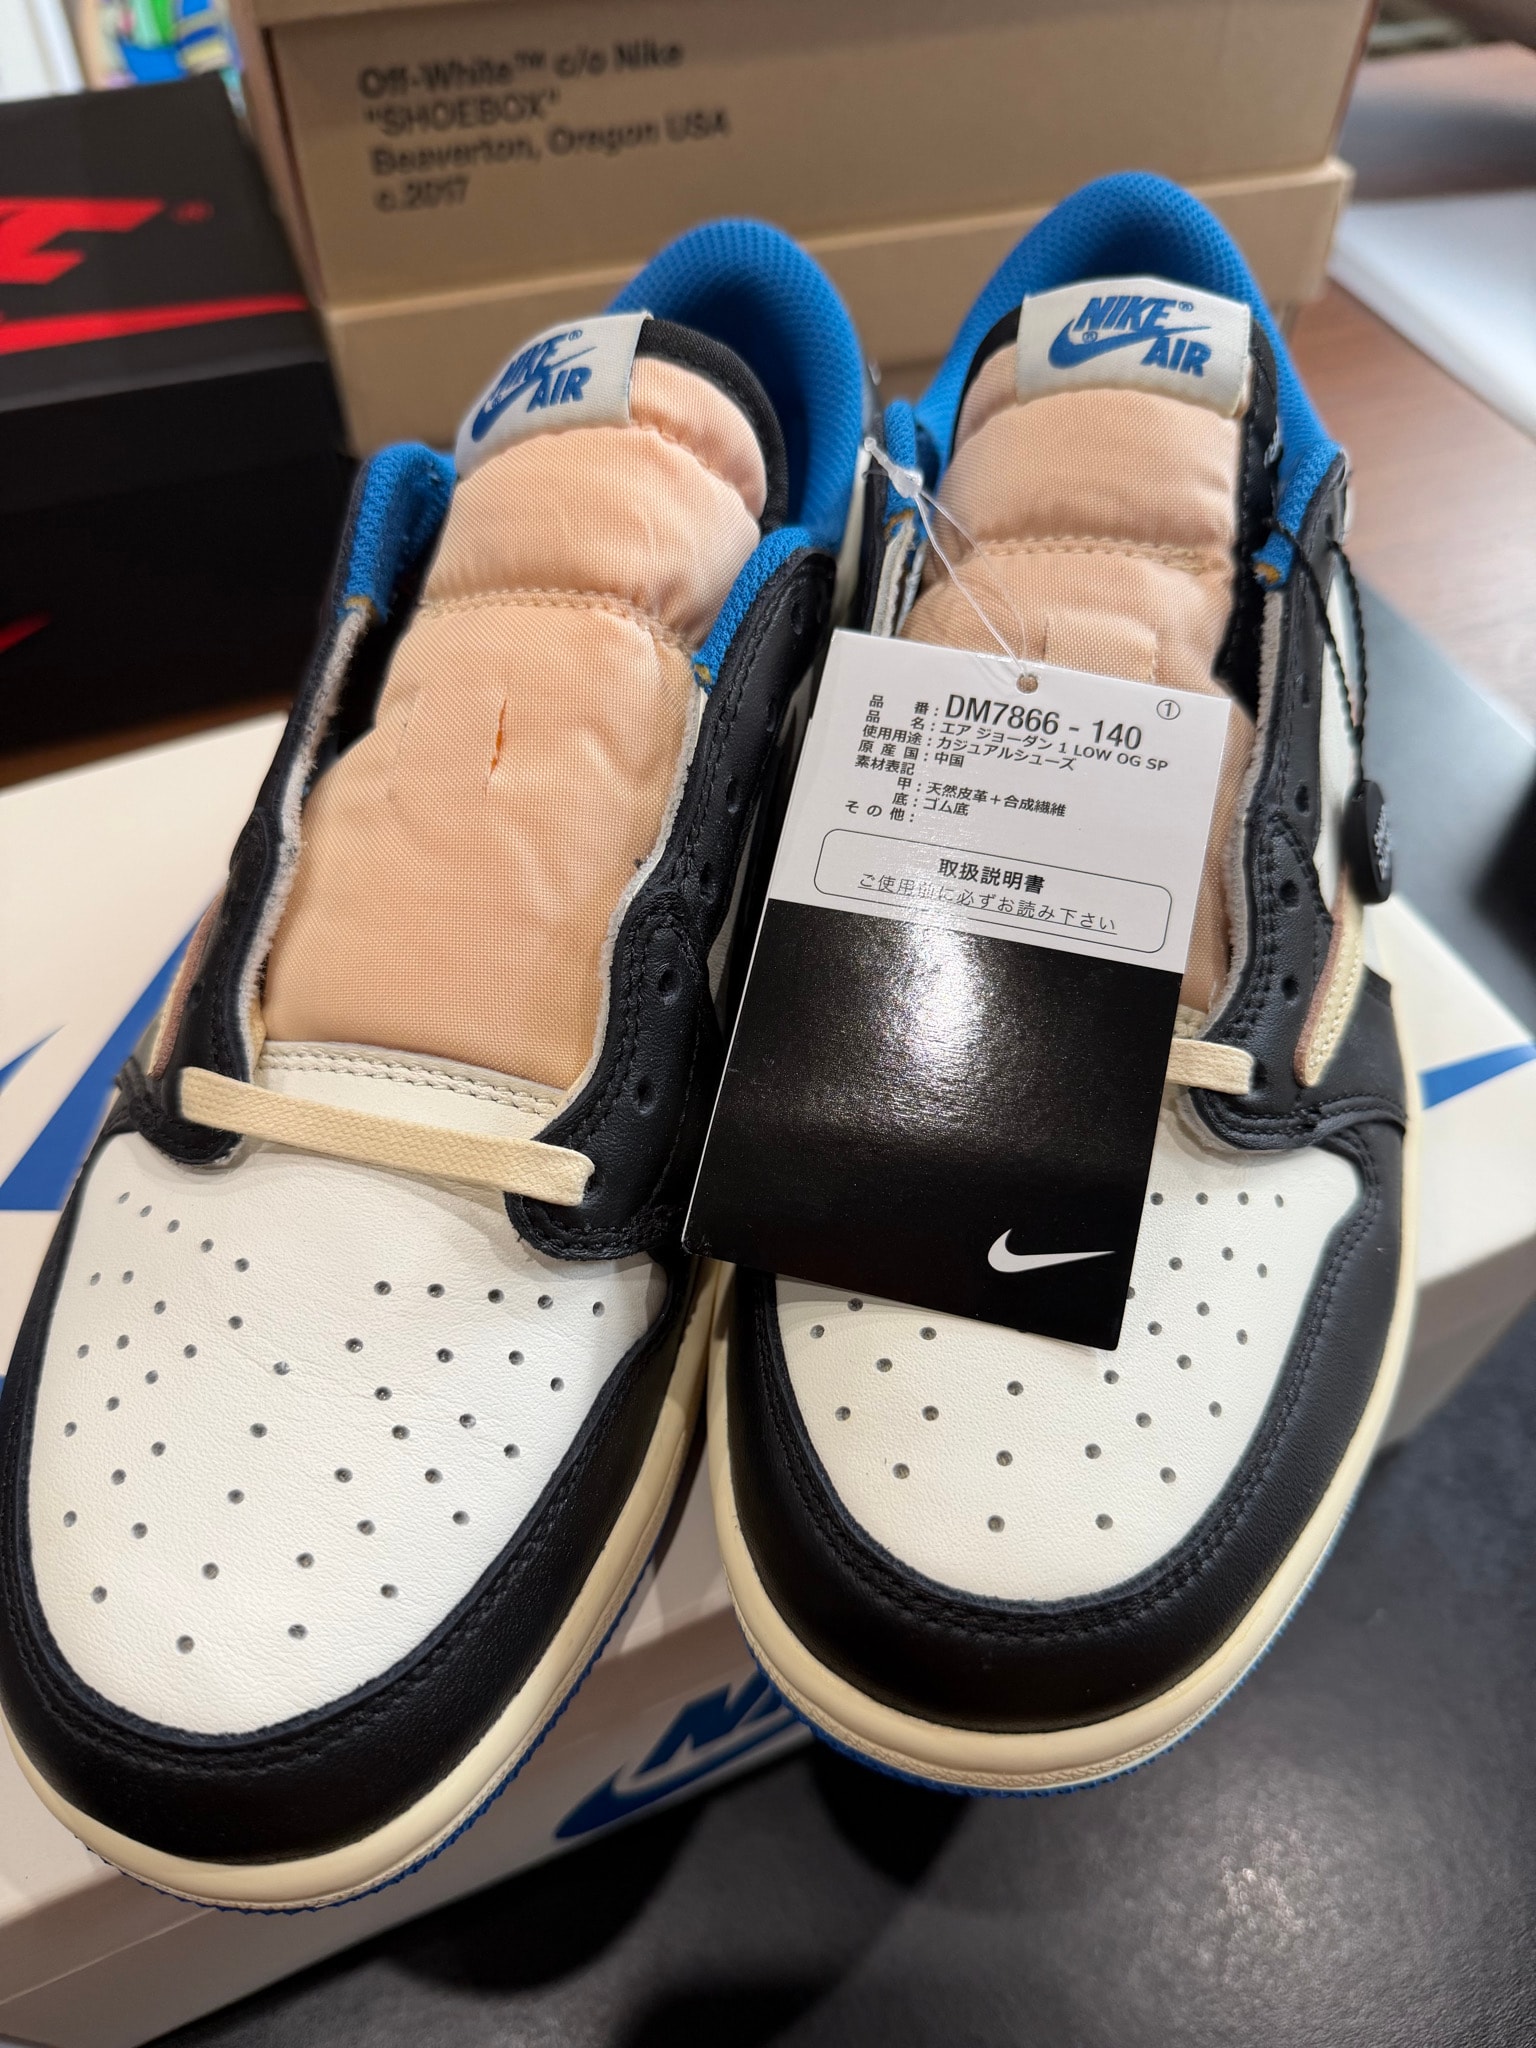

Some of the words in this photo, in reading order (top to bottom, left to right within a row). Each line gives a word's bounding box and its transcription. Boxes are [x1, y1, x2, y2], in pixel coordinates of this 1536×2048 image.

[613, 40, 684, 73] Nike
[547, 123, 660, 157] Oregon
[665, 109, 730, 142] USA
[1073, 296, 1177, 332] NIKE
[1140, 337, 1212, 378] AIR
[526, 367, 592, 412] AIR
[945, 694, 1060, 735] DM7866
[1092, 720, 1142, 749] 140
[1073, 744, 1112, 762] LOW
[1116, 752, 1142, 768] OG
[1145, 758, 1169, 772] SP
[937, 858, 1046, 895] 取扱説明書
